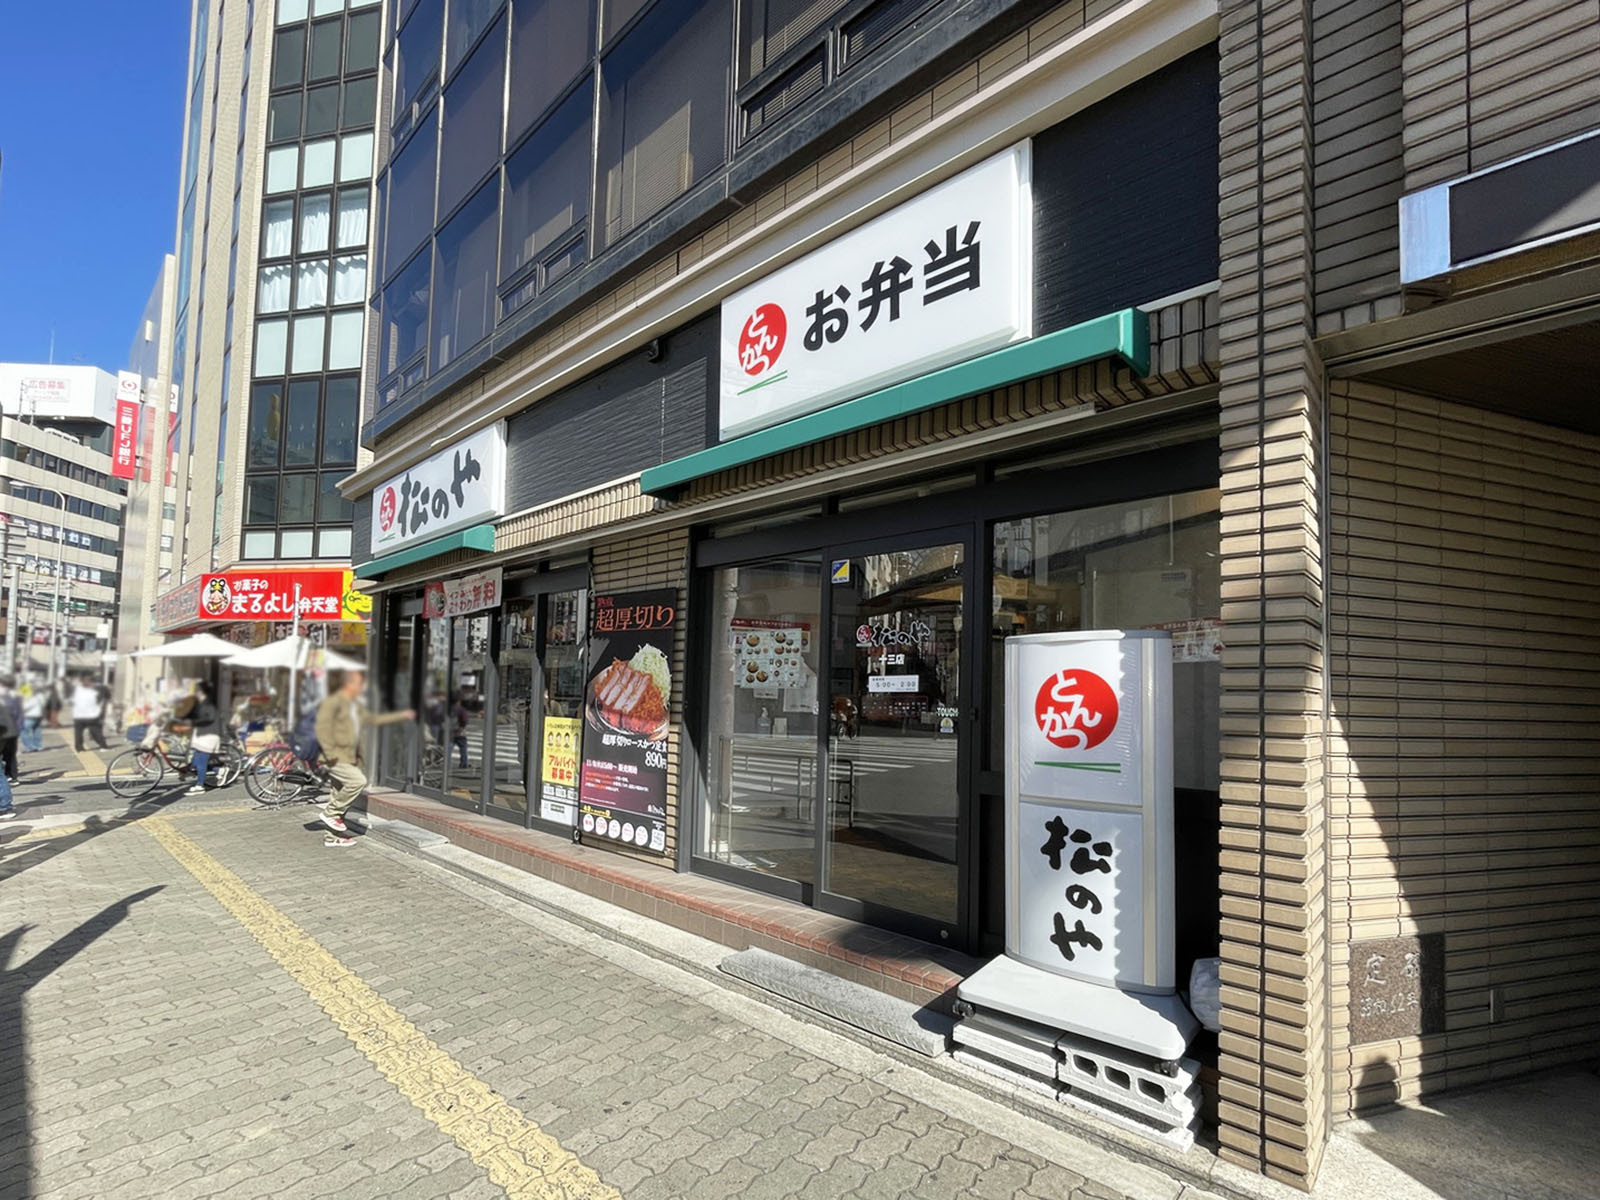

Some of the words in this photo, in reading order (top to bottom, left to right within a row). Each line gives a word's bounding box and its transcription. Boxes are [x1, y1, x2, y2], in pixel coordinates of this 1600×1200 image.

[803, 220, 982, 353] お弁当
[398, 448, 481, 538] 松のや
[233, 578, 269, 591] お菓子の
[595, 604, 675, 631] 超厚切り
[871, 619, 931, 647] 松のや
[1039, 670, 1105, 751] とんかつ
[548, 754, 577, 768] アルバイト
[1039, 815, 1114, 962] 松のや
